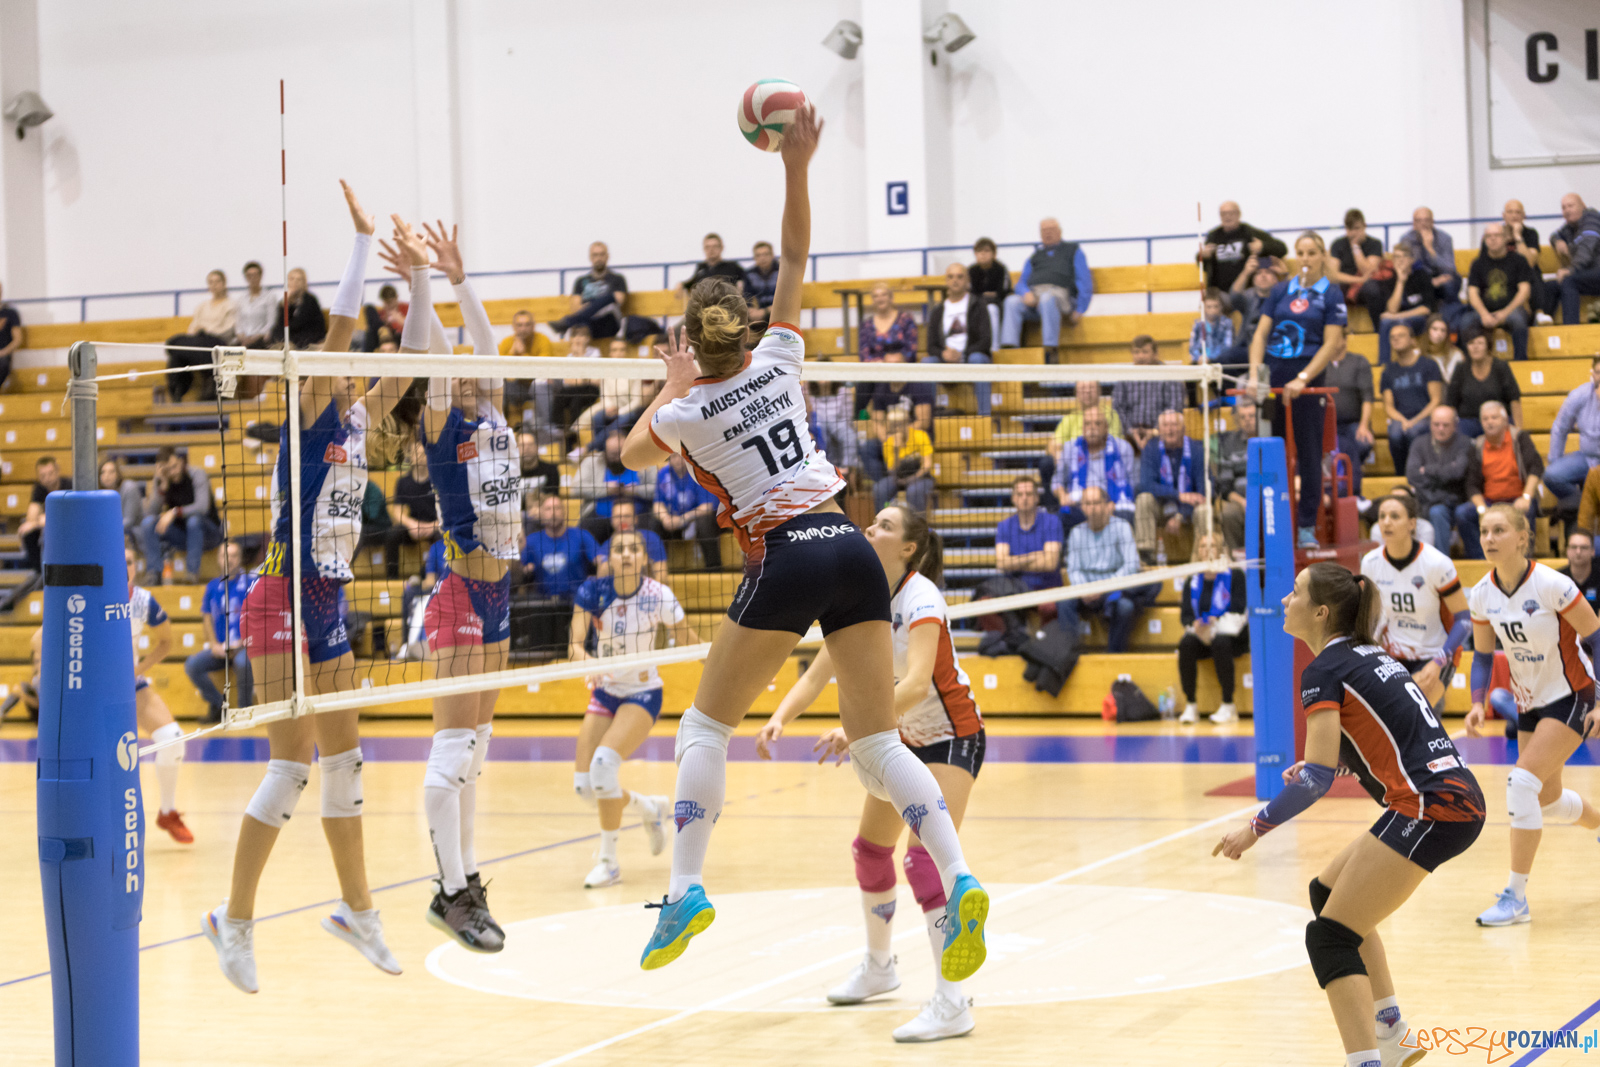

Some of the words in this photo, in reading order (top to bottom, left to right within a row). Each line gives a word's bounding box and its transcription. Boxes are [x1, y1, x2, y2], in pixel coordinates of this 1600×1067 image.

[890, 185, 905, 210] C
[701, 366, 787, 420] MUSZYŃSKA
[723, 391, 793, 441] ENERGETYK
[740, 395, 769, 419] ENEA
[488, 435, 509, 452] 18
[741, 419, 803, 476] 19
[1391, 592, 1416, 613] 99
[614, 621, 625, 635] 6
[1397, 620, 1427, 631] Enea
[1500, 621, 1528, 643] 16
[1513, 652, 1545, 663] Enea
[1404, 682, 1439, 728] 8
